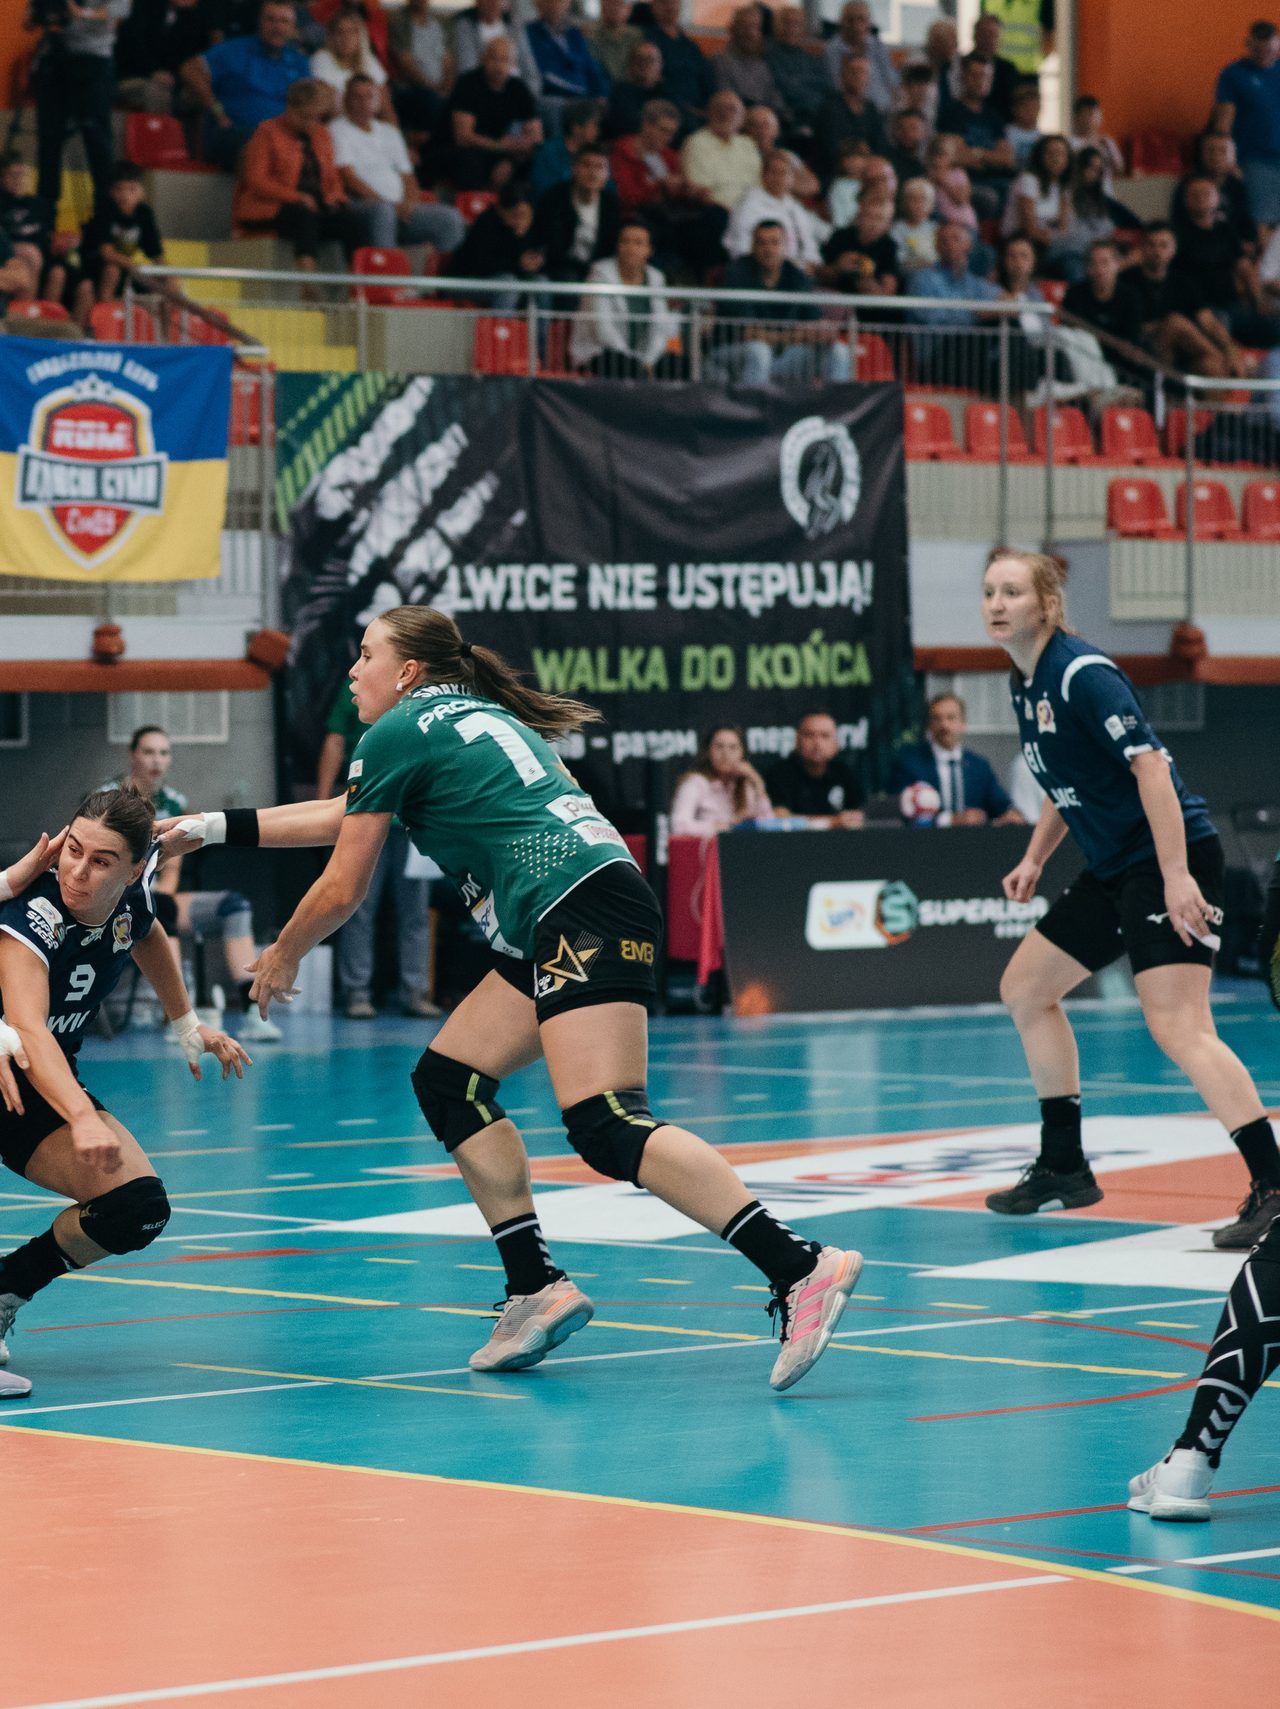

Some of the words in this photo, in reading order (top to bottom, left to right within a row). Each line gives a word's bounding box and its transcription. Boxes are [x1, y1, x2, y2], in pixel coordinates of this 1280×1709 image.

[446, 562, 578, 612] LWICE
[587, 562, 658, 611] NIE
[666, 559, 875, 619] USTĘPUJĄ!
[531, 645, 669, 694] WALKA
[679, 644, 736, 691] DO
[745, 627, 872, 690] KOŃCA
[64, 963, 96, 1002] 9
